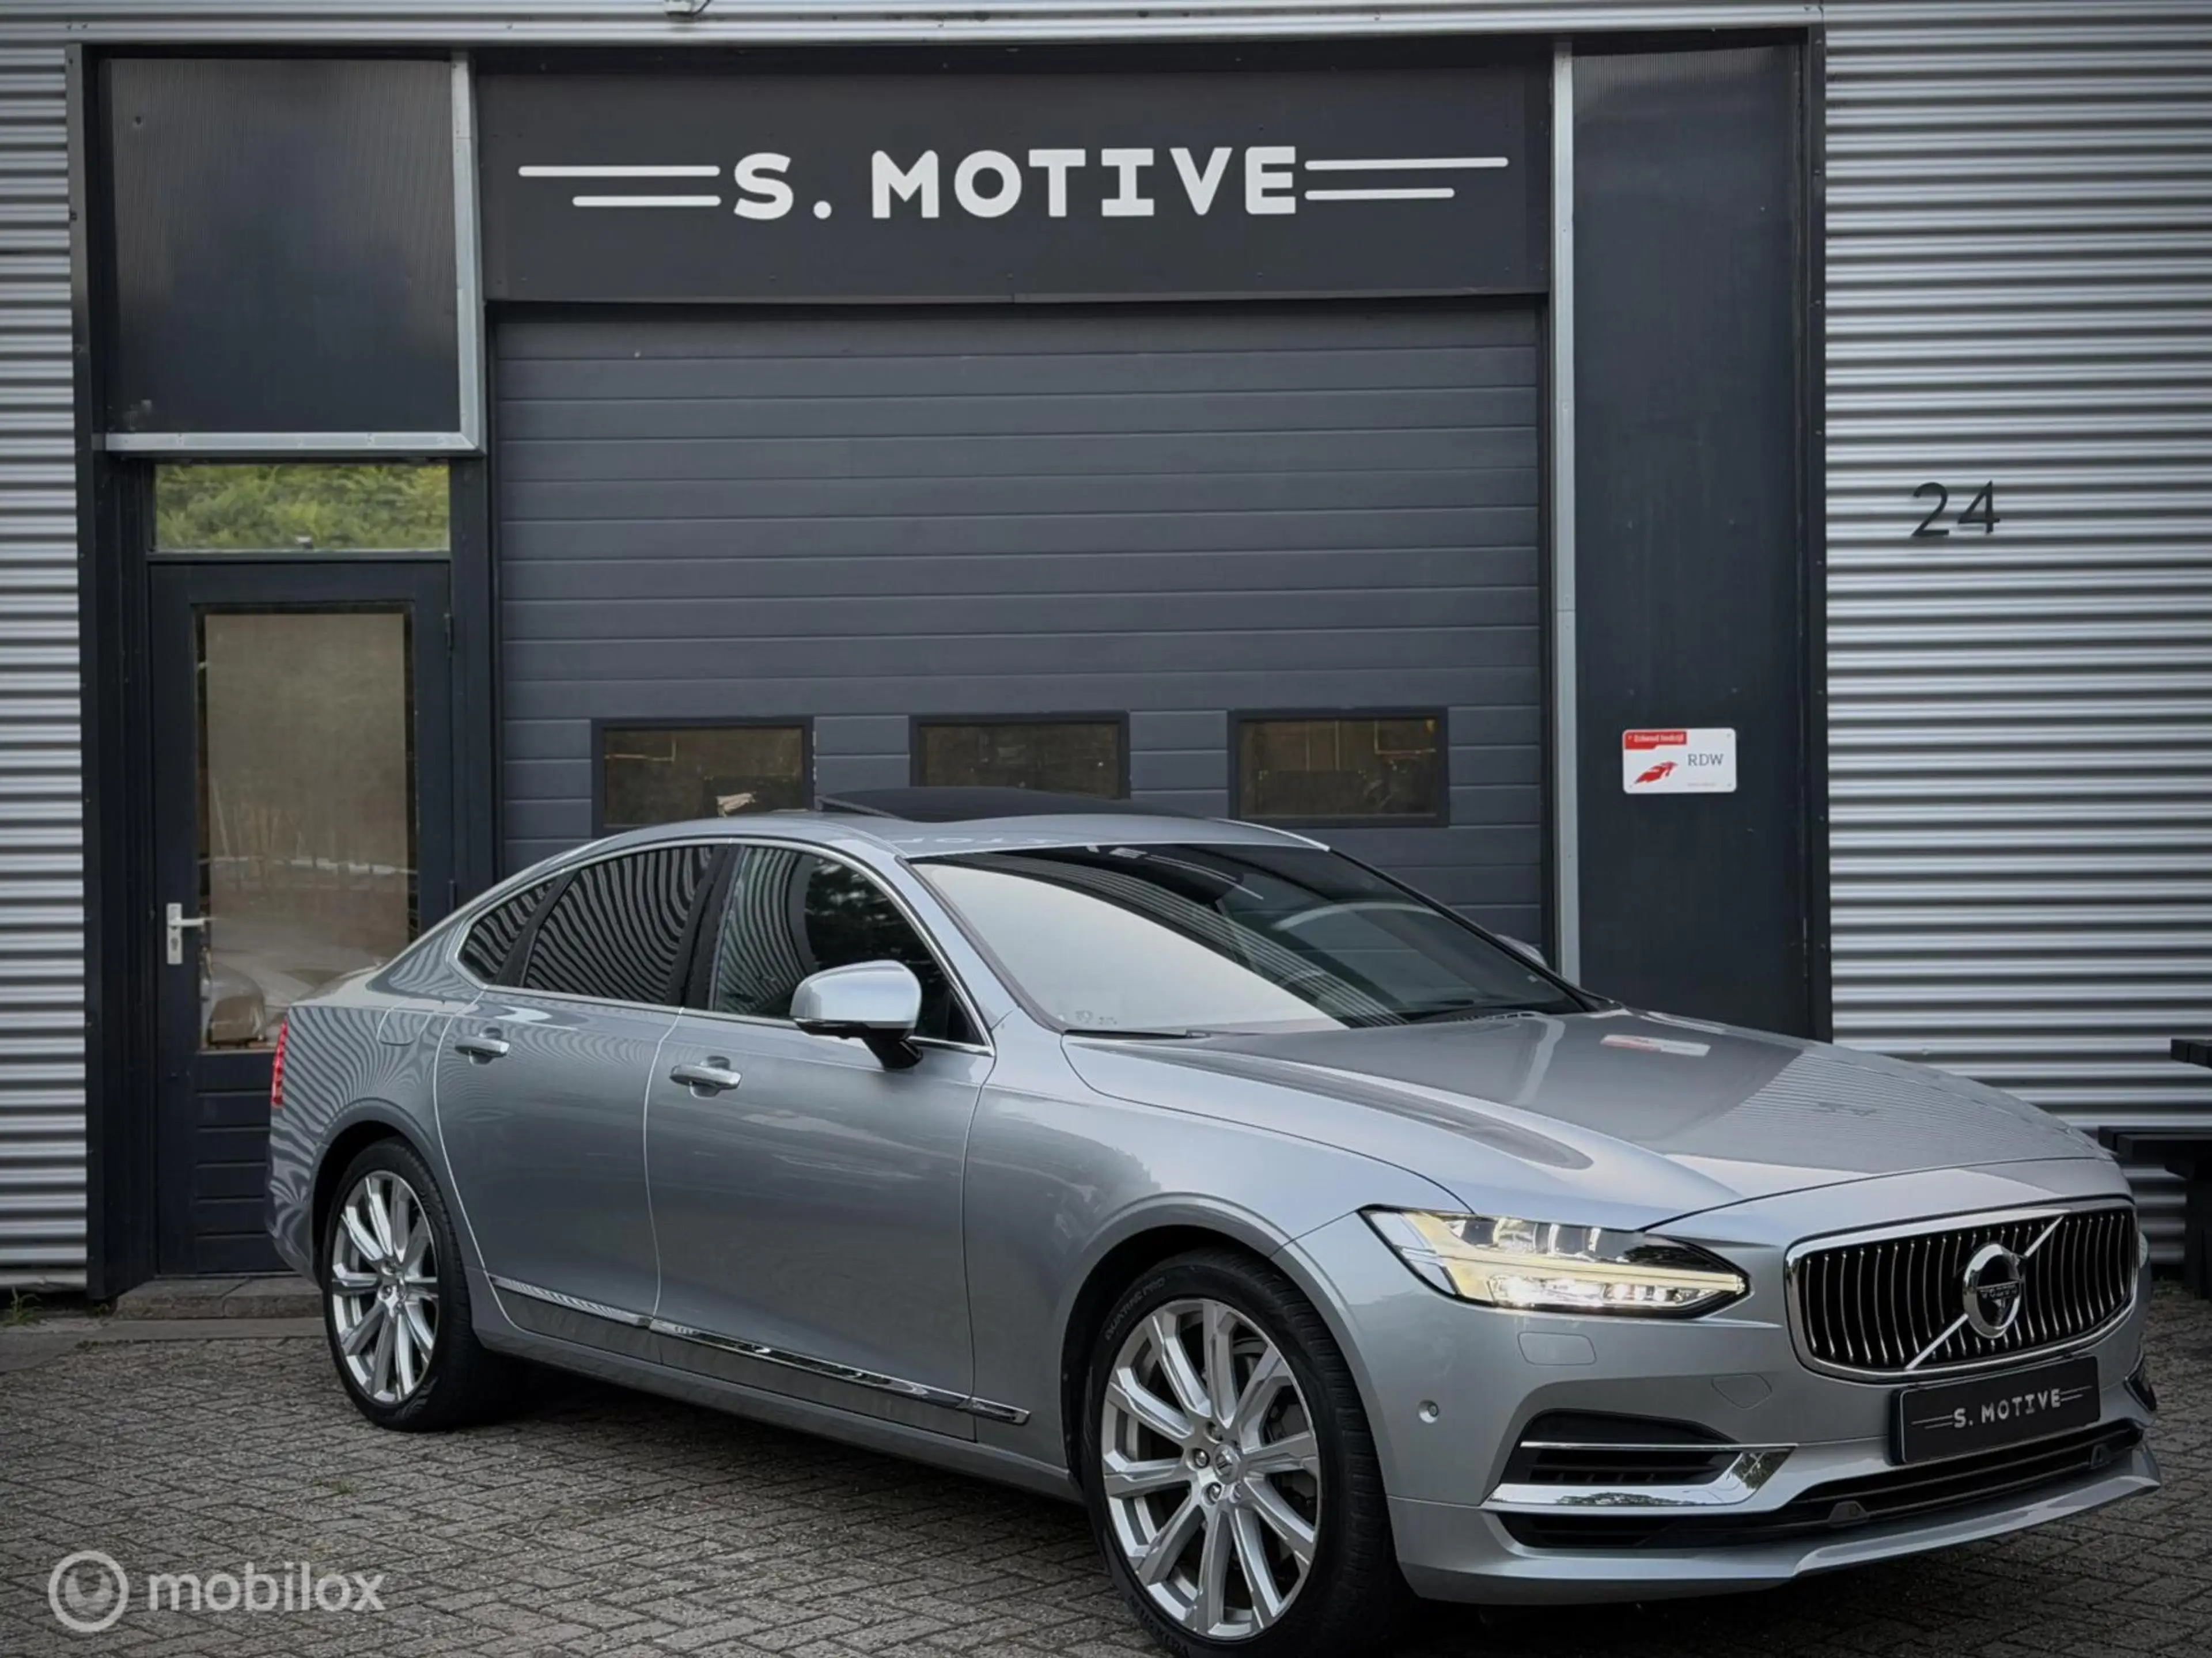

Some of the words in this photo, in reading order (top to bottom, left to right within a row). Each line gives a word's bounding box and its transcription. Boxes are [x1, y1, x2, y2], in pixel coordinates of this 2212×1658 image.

[733, 152, 832, 220] S.
[871, 146, 1297, 219] MOTIVE
[1911, 479, 2001, 537] 24
[1687, 753, 1725, 767] RDW
[1953, 1407, 1974, 1429] S.
[1980, 1388, 2061, 1424] MOTIVE
